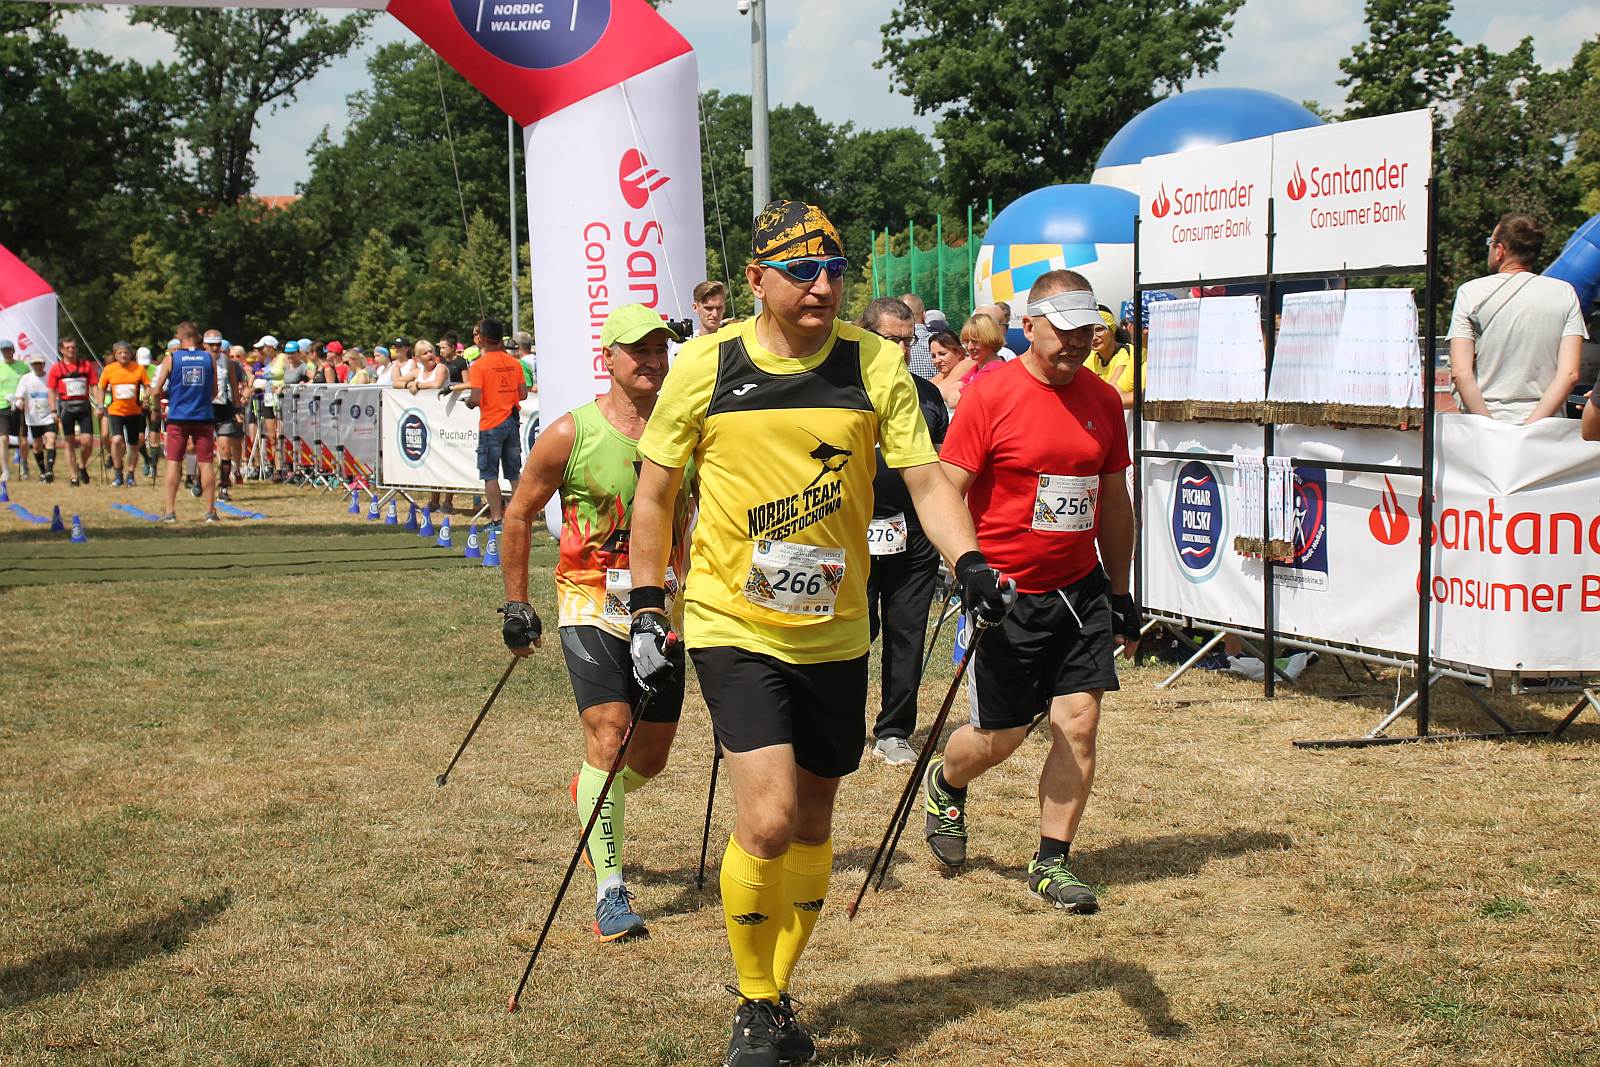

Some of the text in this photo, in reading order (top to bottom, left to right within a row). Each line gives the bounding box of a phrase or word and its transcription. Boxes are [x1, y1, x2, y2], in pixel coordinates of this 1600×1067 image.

[494, 3, 544, 15] NORDIC
[490, 19, 551, 31] WALKING
[1310, 158, 1408, 198] Santander
[1173, 180, 1254, 216] Santander
[1310, 200, 1406, 229] Consumer Bank
[1172, 216, 1252, 243] Consumer Bank
[1055, 497, 1088, 516] 256
[1182, 488, 1211, 506] PUCHAR
[747, 480, 842, 539] NORDIC TEAM
[1182, 510, 1212, 530] POLSKI
[867, 529, 894, 542] 276
[772, 569, 822, 596] 266
